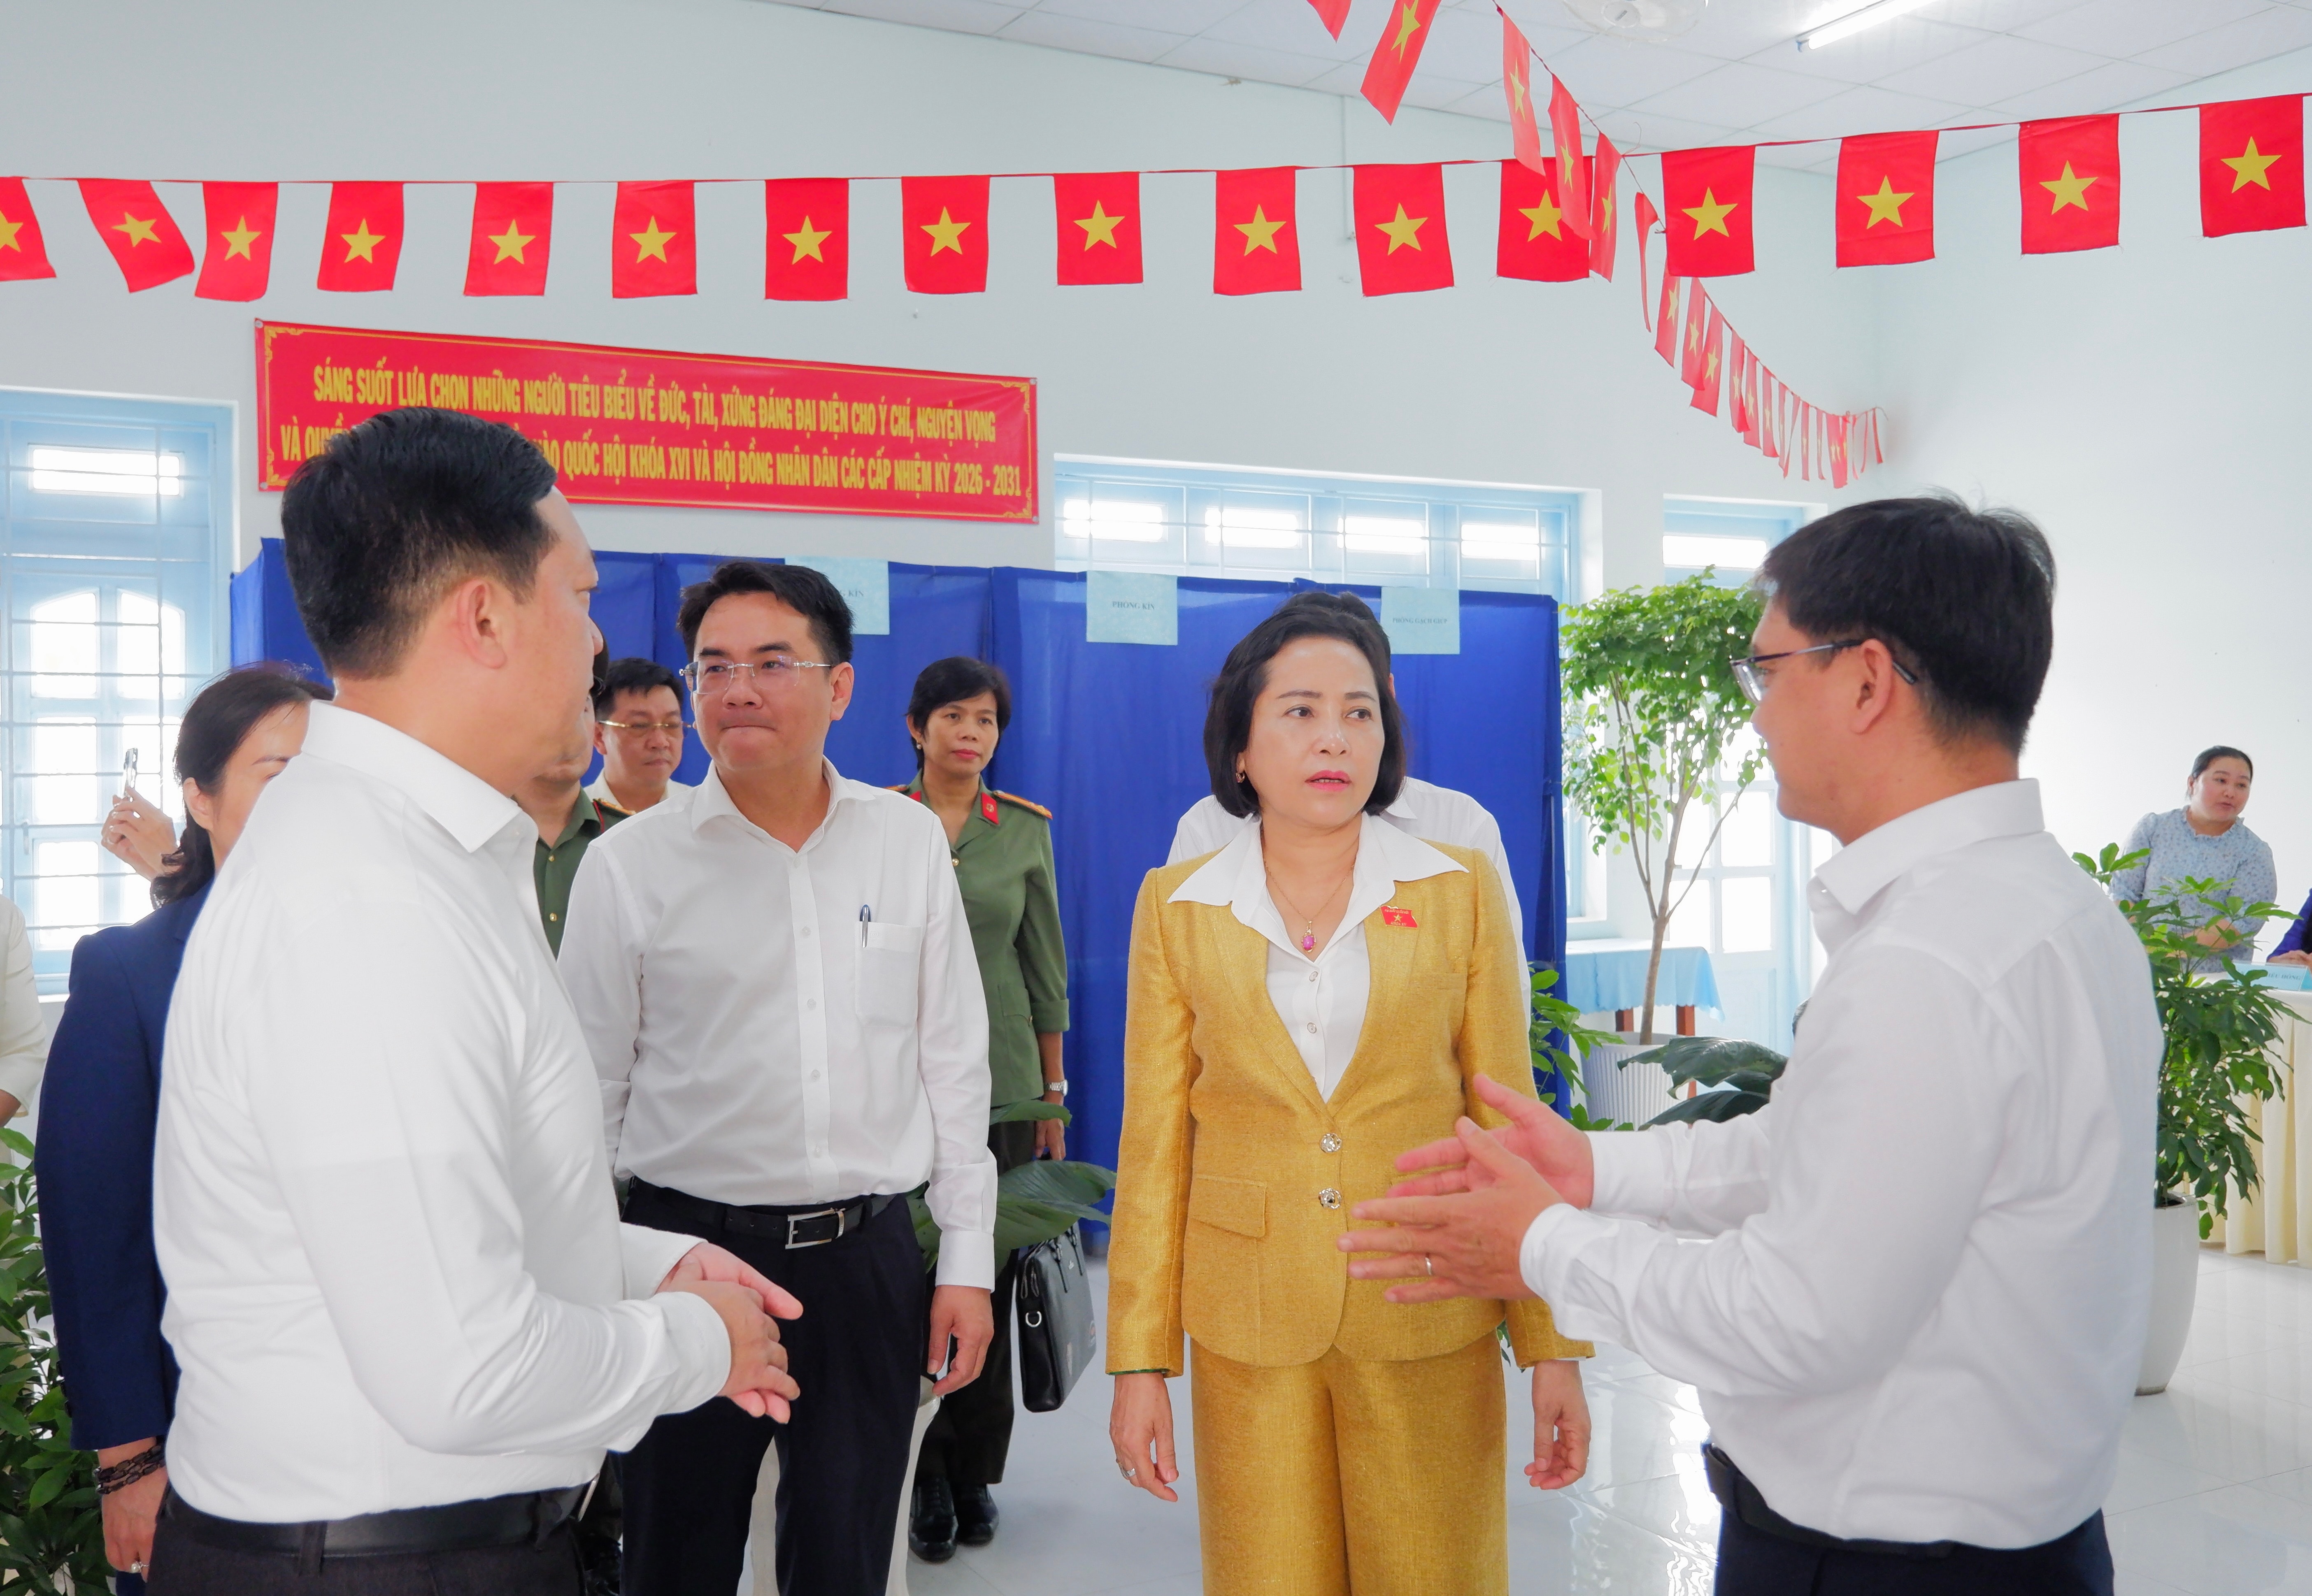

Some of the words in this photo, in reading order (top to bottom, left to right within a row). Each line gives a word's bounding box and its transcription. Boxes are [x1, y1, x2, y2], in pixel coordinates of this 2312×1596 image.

[314, 356, 353, 404] SÁNG
[356, 355, 394, 406] SUỐT
[472, 369, 521, 413] NHỮNG
[523, 372, 566, 416] NGƯỜI
[568, 374, 600, 418] TIÊU
[603, 368, 635, 421] BIỂU
[637, 374, 656, 421] VỀ
[659, 376, 690, 430] ĐỨC,
[693, 383, 718, 432] TÀI,
[721, 385, 756, 428] XỨNG
[758, 388, 793, 430] ĐÁNG
[795, 398, 817, 439] ĐẠI
[819, 392, 849, 441] DIỆN
[851, 402, 876, 436] CHO
[878, 395, 887, 436] Ý
[890, 397, 914, 444] CHÍ,
[917, 400, 963, 447] NGUYỆN
[965, 410, 996, 448] VỌNG
[280, 416, 301, 461] VÀ
[563, 428, 600, 481] QUỐC
[603, 434, 626, 485] HỘI
[629, 436, 666, 479] KHÓA
[668, 447, 690, 481] XVI
[693, 439, 711, 481] VÀ
[713, 441, 736, 490] HỘI
[738, 437, 774, 485] ĐỒNG
[776, 445, 810, 486] NHÂN
[813, 447, 838, 488] DÂN
[841, 448, 865, 489] CÁC
[868, 446, 892, 490] CẤP
[894, 452, 932, 499] NHIỆM
[935, 453, 951, 493] KỲ
[954, 462, 983, 495] 2026
[993, 464, 1021, 497] 2031
